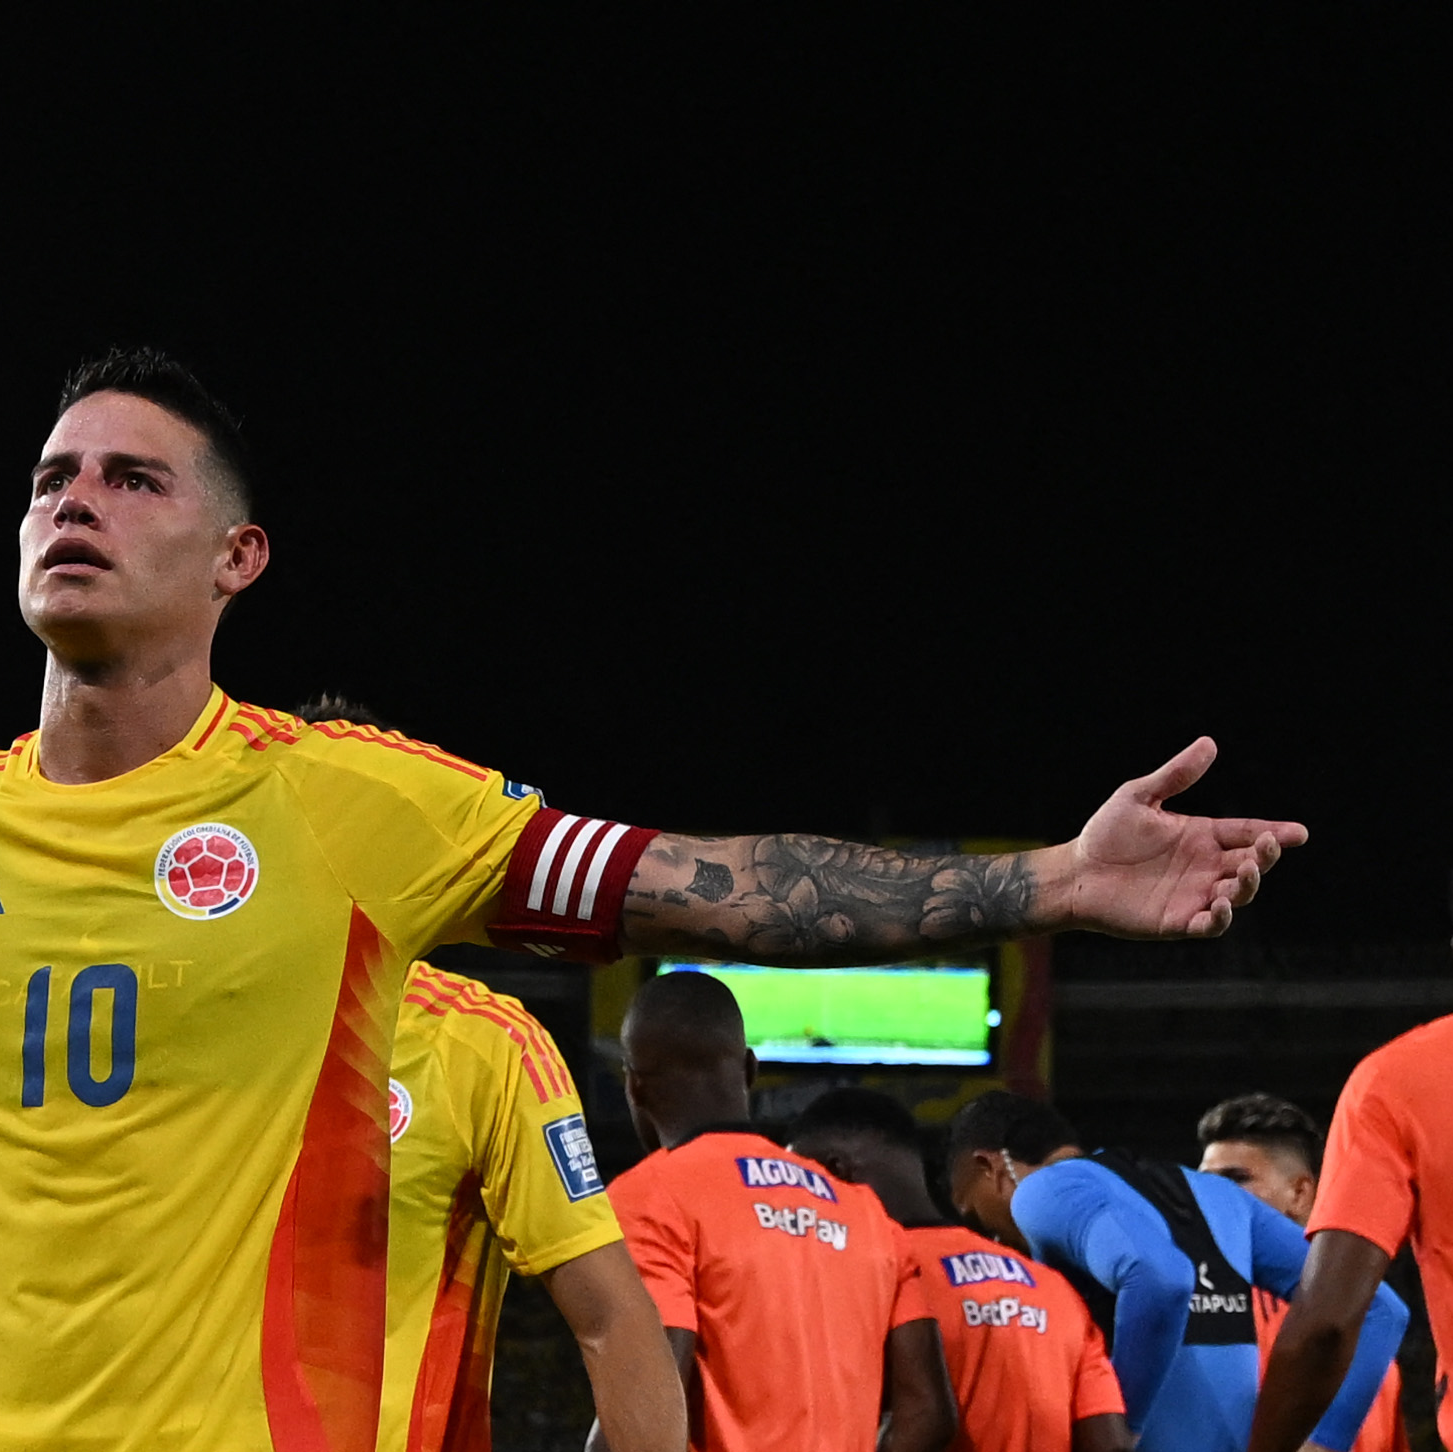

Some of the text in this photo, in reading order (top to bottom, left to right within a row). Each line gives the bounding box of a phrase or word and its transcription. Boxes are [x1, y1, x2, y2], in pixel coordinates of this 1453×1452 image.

[21, 963, 138, 1108] 10
[746, 1158, 833, 1201] AGUILA
[753, 1203, 848, 1251] BetPlay
